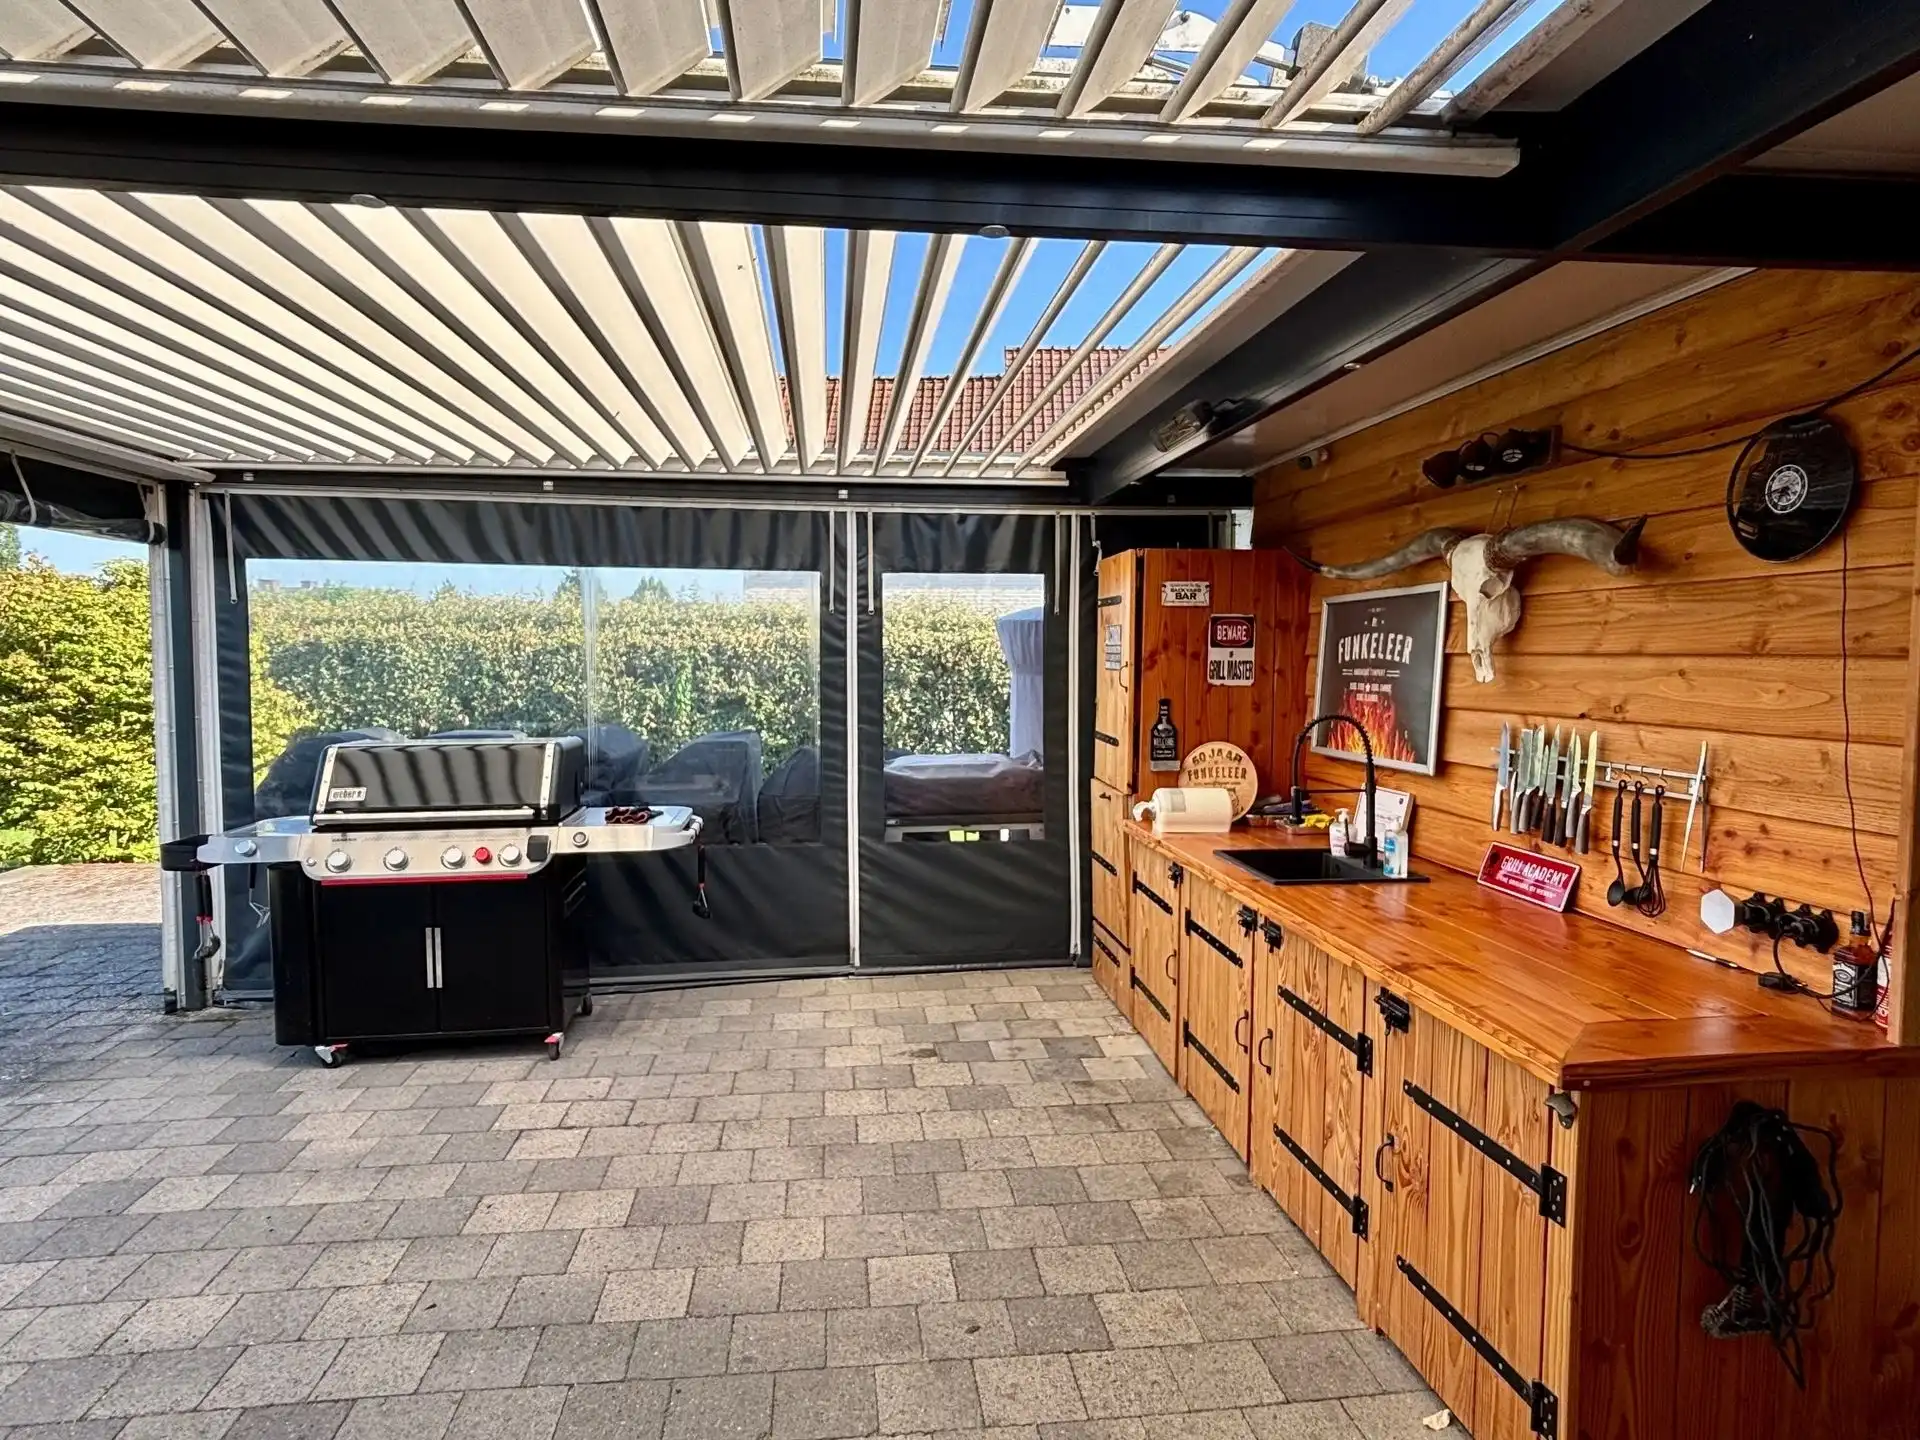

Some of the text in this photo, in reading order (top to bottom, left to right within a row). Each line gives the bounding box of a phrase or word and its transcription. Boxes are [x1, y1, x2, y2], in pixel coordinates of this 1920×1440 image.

[1216, 625, 1248, 641] BEWARE
[1338, 632, 1413, 665] FUNKELEER
[1208, 660, 1254, 681] GRILL MASTER
[1192, 748, 1243, 766] 50 JAAR
[1187, 766, 1247, 781] FUNKELEER
[1501, 855, 1570, 888] GRILL ACADEMY
